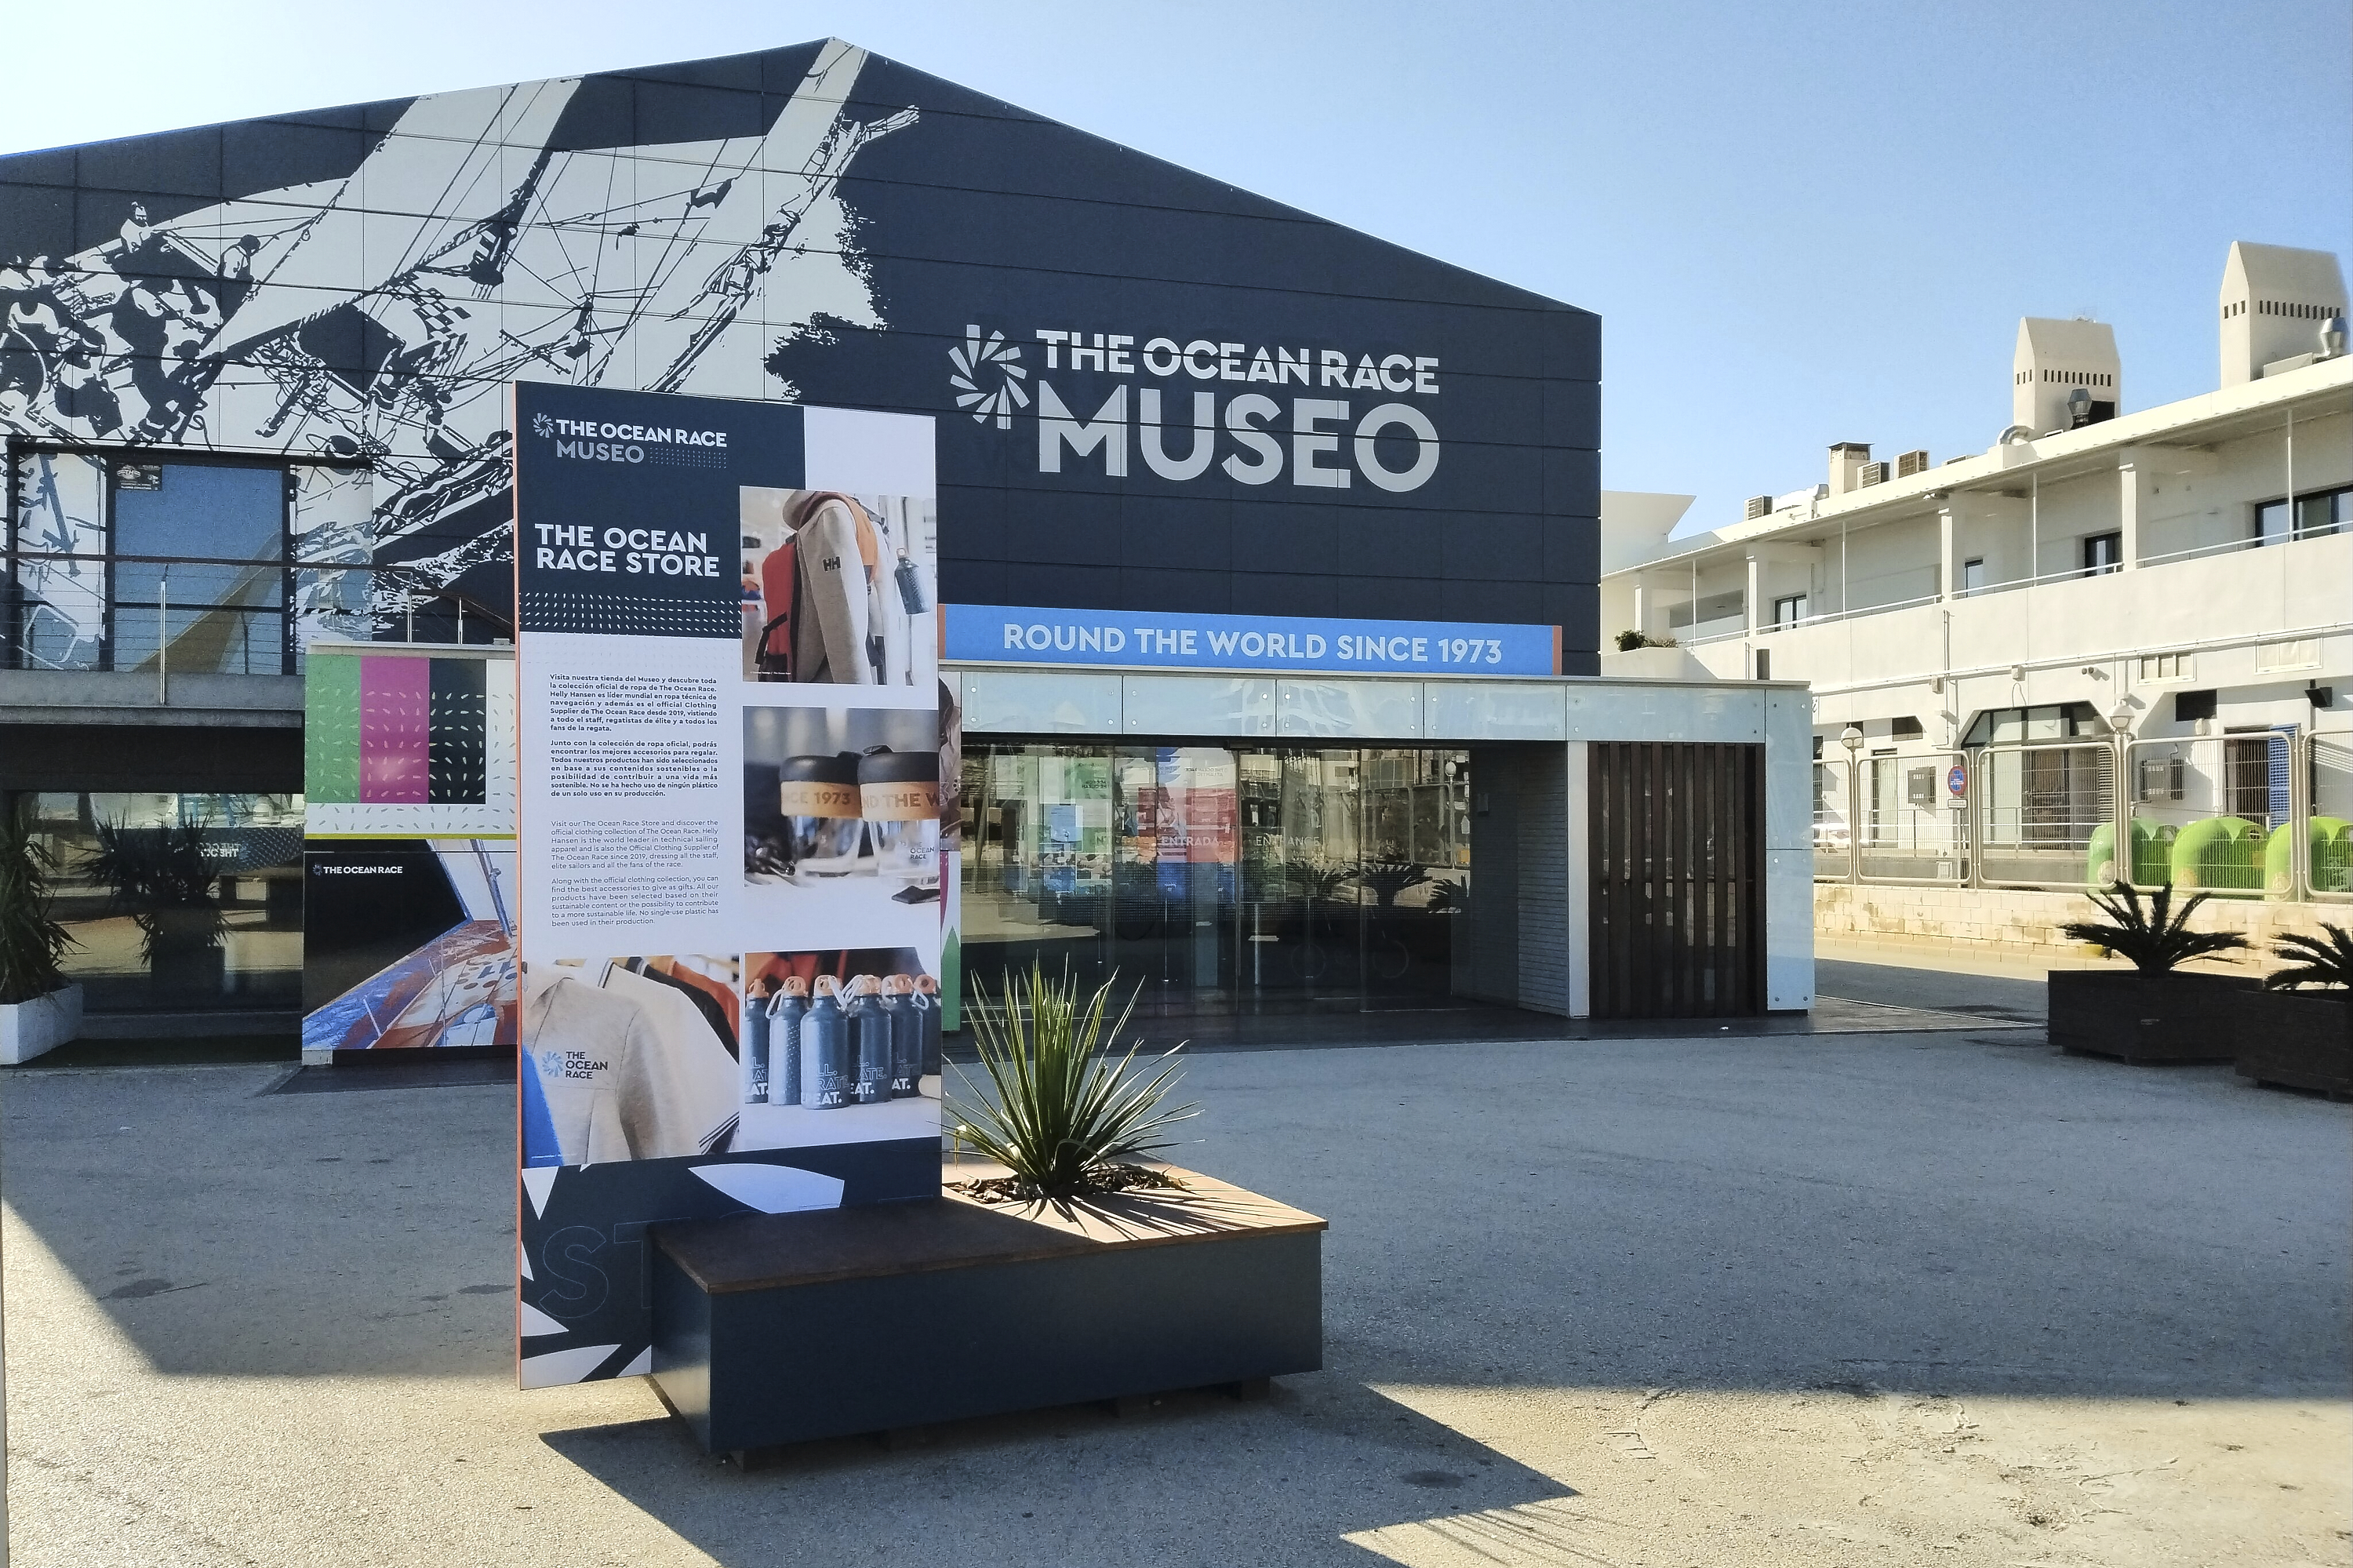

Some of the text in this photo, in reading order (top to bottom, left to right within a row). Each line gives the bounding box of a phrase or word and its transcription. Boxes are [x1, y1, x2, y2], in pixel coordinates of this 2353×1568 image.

[1036, 329, 1439, 394] THE OCEAN RACE
[556, 419, 727, 448] THE OCEAN RACE
[1039, 380, 1440, 493] MUSEO
[556, 439, 645, 464] MUSEO
[535, 523, 707, 554] THE OCEAN
[536, 548, 720, 577] RACE STORE
[823, 556, 841, 572] HH
[1003, 623, 1503, 665] ROUND THE WORLD SINCE 1973
[550, 690, 568, 700] Helly
[550, 699, 595, 708] navegación
[685, 701, 717, 710] Clothing
[550, 708, 579, 716] Supplier
[668, 709, 686, 718] 2019,
[585, 716, 604, 725] staff,
[606, 717, 642, 726] regatistas
[586, 725, 612, 733] regata.
[693, 740, 717, 749] podrás
[690, 748, 718, 757] regalar.
[605, 756, 640, 765] productos
[551, 773, 596, 781] posibilidad
[692, 781, 718, 790] plástico
[624, 789, 666, 798] producción.
[813, 791, 851, 806] 1973
[882, 792, 921, 808] THE
[1162, 836, 1220, 846] ENTRADA
[323, 866, 403, 875] THE OCEAN RACE
[566, 1051, 585, 1060] THE
[566, 1060, 609, 1071] OCEAN
[566, 1071, 593, 1079] RACE
